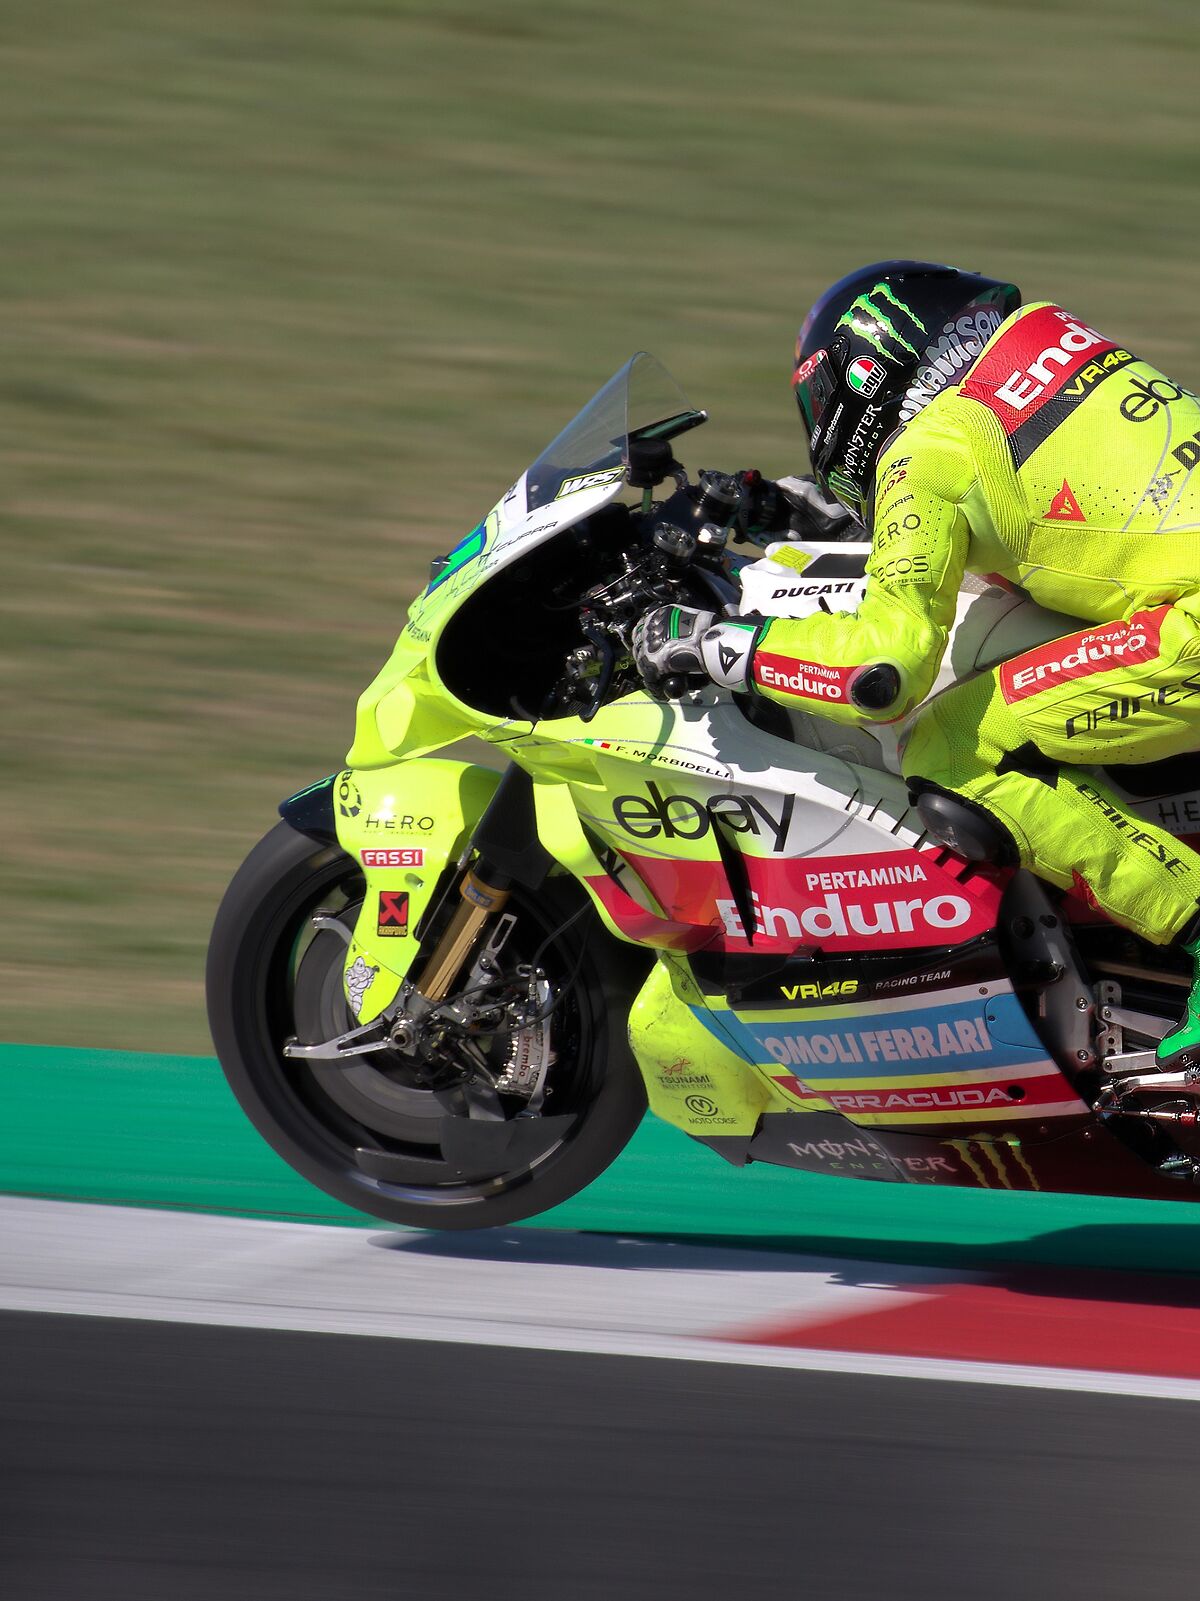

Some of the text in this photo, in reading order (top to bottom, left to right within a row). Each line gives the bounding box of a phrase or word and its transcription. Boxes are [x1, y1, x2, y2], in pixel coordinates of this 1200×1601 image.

[861, 366, 881, 395] agv
[771, 583, 855, 599] DUCATI
[799, 663, 841, 680] PERTAMINA
[1012, 633, 1147, 690] Enduro
[760, 665, 842, 698] Enduro
[616, 745, 730, 778] F. MORBIDELLI
[365, 814, 435, 831] HERO
[612, 781, 796, 852] ebay
[1076, 783, 1191, 878] DAINESE
[365, 851, 420, 865] FASSI
[806, 865, 928, 892] PERTAMINA
[716, 894, 971, 938] Enduro
[875, 976, 918, 990] RACING
[919, 970, 951, 985] TEAM
[859, 1016, 993, 1063] FERRARI
[518, 1036, 534, 1077] brembo
[658, 1075, 710, 1084] TSUNAMI
